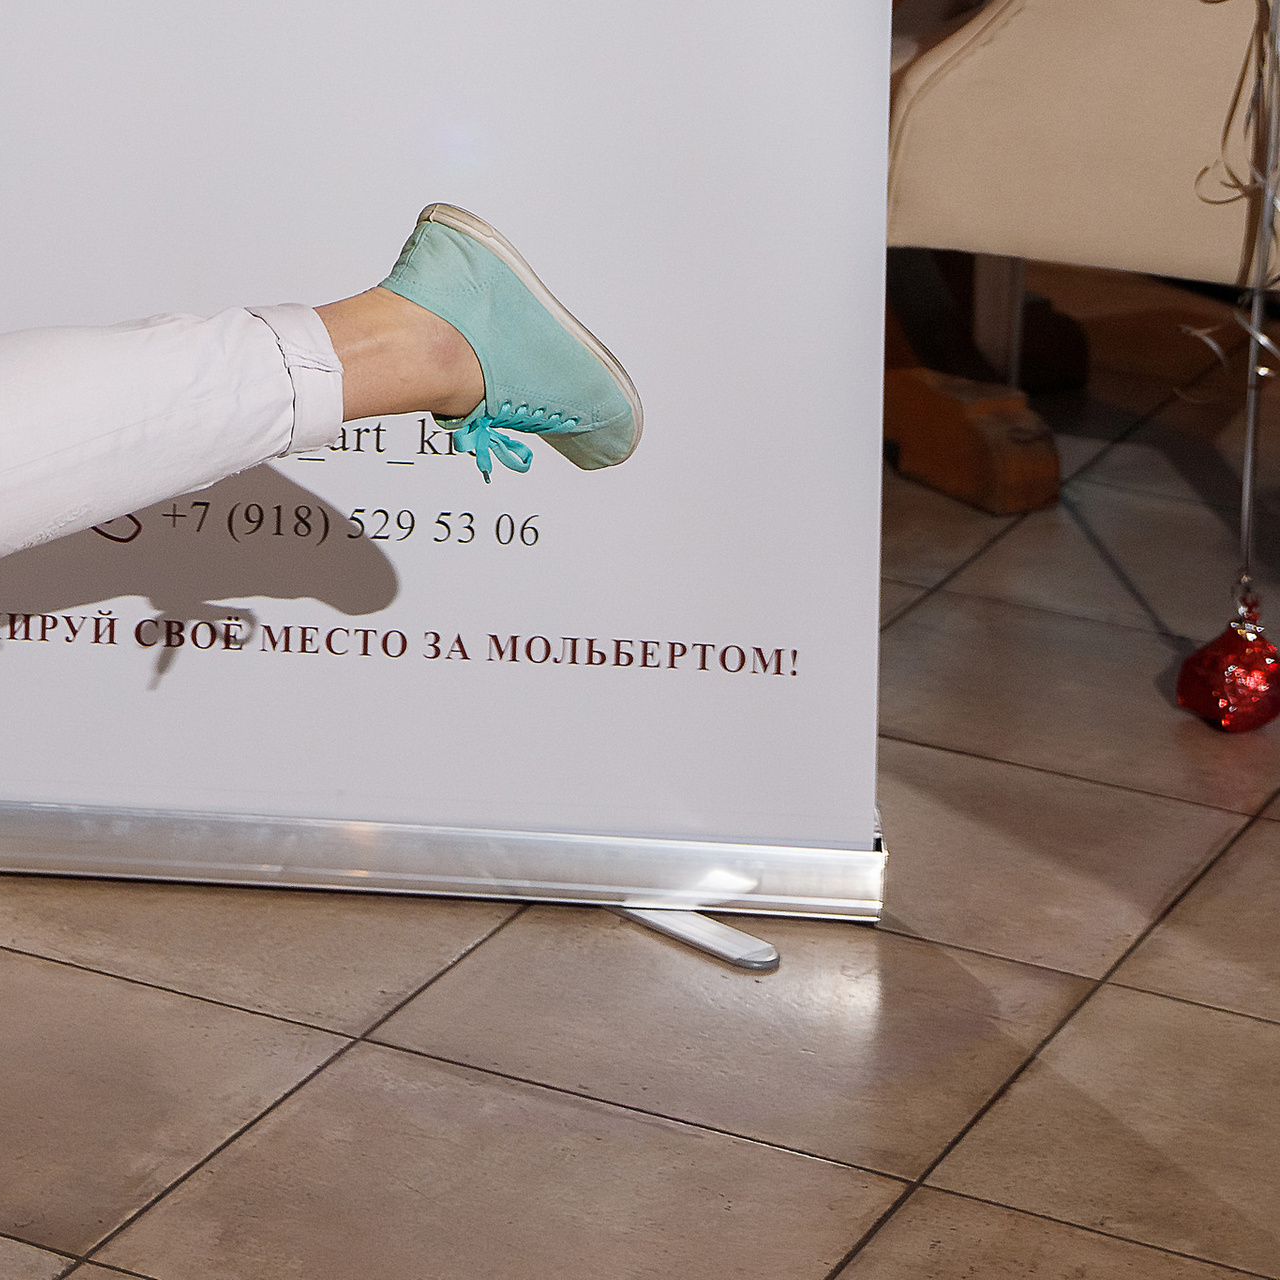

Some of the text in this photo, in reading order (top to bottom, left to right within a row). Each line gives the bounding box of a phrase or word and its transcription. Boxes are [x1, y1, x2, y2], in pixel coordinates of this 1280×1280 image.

[162, 501, 540, 546] +7 (918) 529 53 06
[134, 610, 244, 652] СВОЁ
[259, 624, 408, 659] МЕСТО
[422, 631, 473, 662] ЗА
[486, 633, 799, 677] МОЛЬБЕРТОМ!
